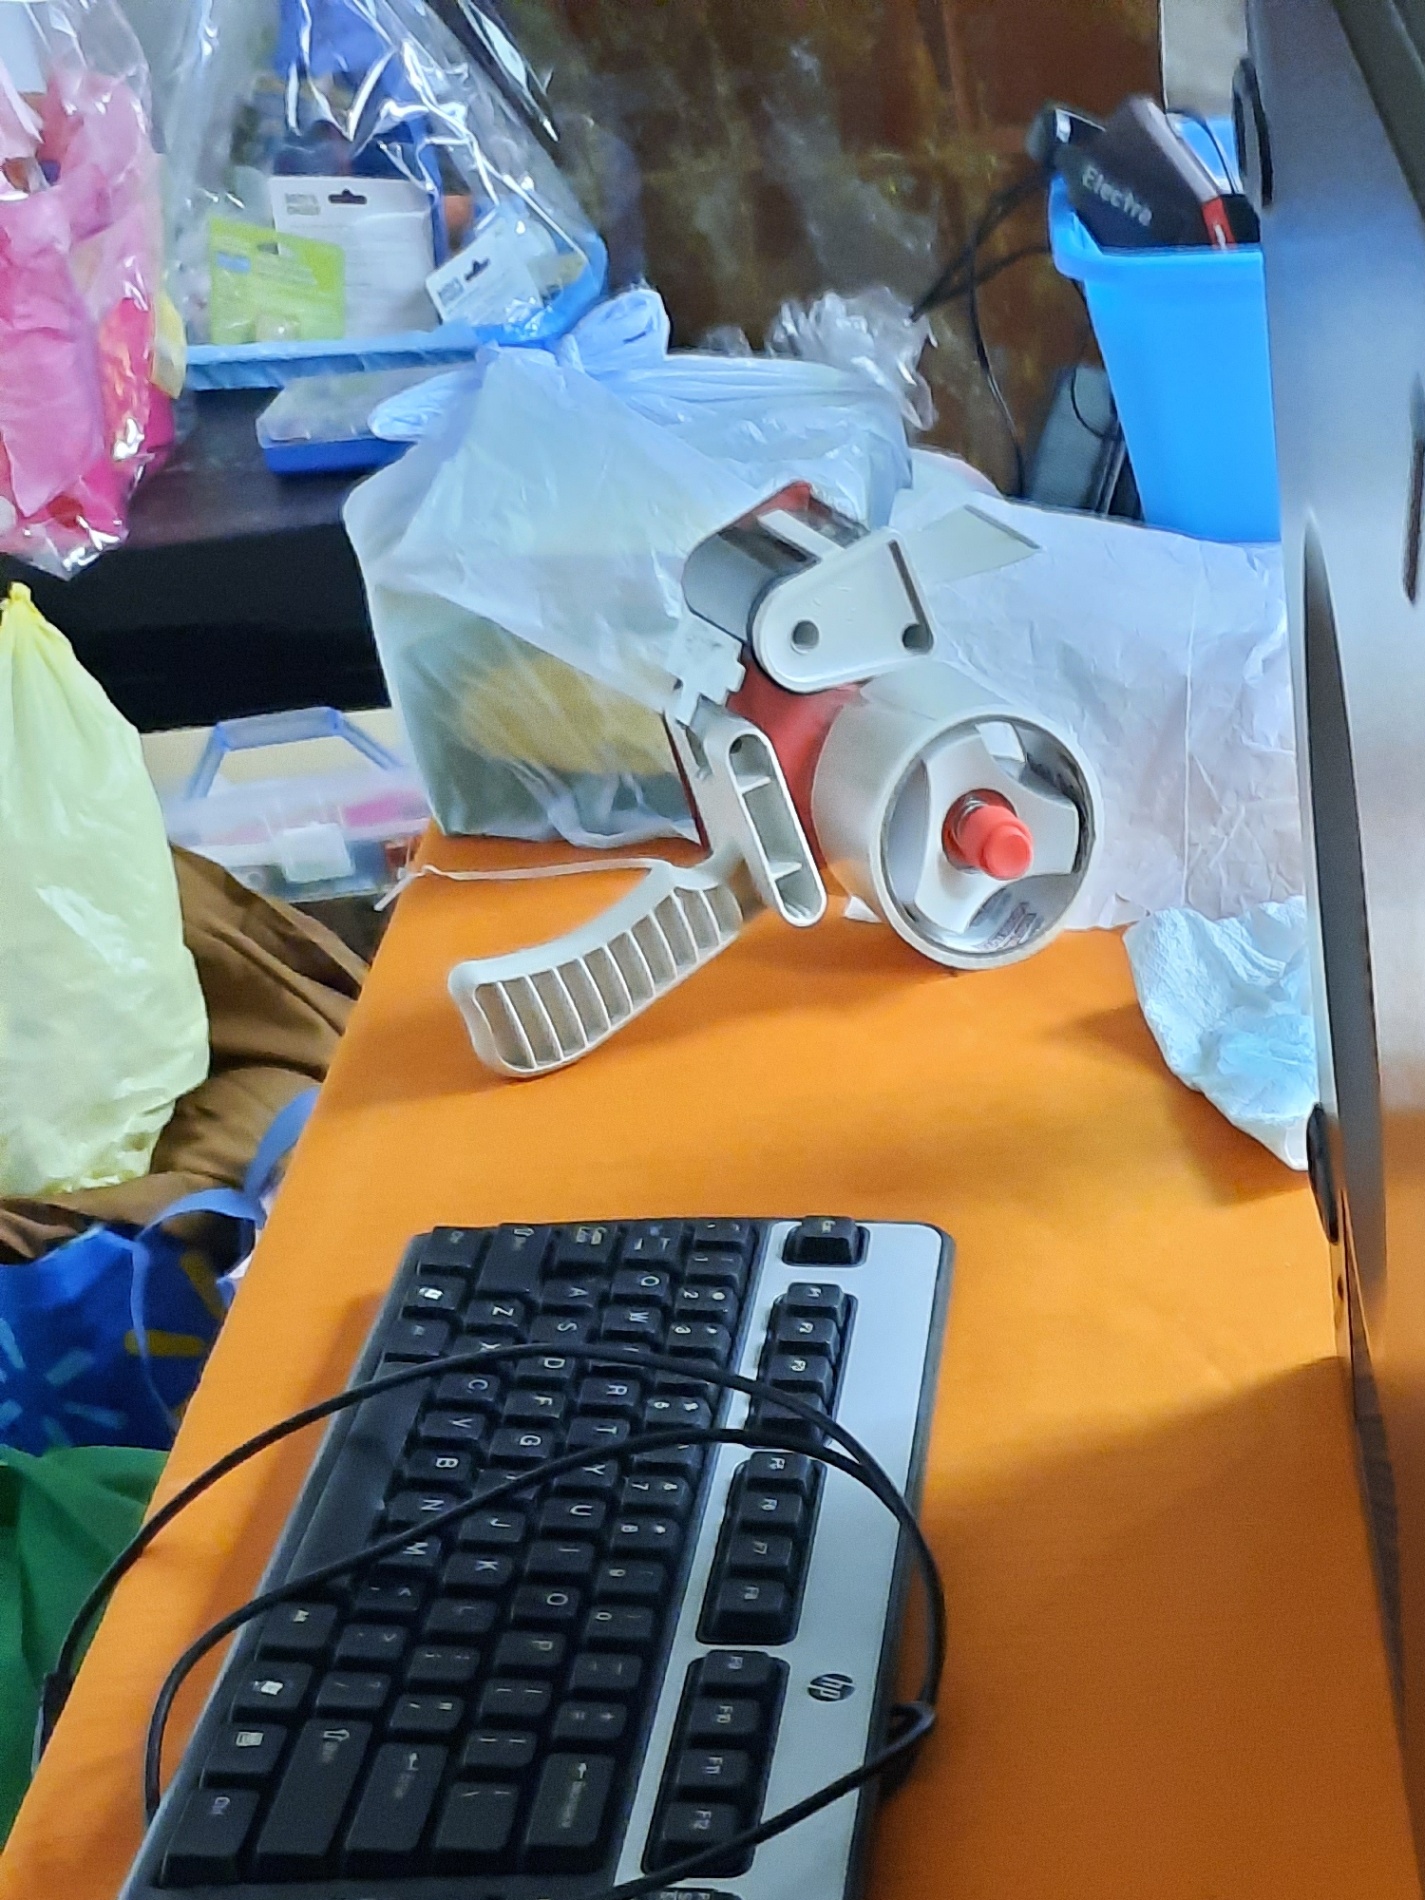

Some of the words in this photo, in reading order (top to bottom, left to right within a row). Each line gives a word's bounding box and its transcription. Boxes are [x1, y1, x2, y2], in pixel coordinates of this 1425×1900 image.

[568, 1286, 589, 1298] A
[684, 1291, 699, 1300] 2
[492, 1305, 514, 1317] Z
[629, 1310, 649, 1324] W
[557, 1321, 578, 1333] S
[543, 1357, 566, 1370] D
[467, 1378, 489, 1392] C
[606, 1384, 629, 1396] R
[534, 1395, 553, 1407] F
[450, 1417, 473, 1429] V
[594, 1425, 618, 1436] T
[519, 1434, 542, 1447] G
[435, 1456, 459, 1470] B
[582, 1463, 606, 1476] Y
[631, 1482, 650, 1491] 7
[420, 1498, 444, 1512] N
[569, 1504, 593, 1517] U
[489, 1516, 512, 1528] J
[402, 1541, 428, 1555] M
[475, 1559, 499, 1571] K
[546, 1592, 569, 1606] O
[595, 1611, 613, 1621] 0
[531, 1639, 553, 1650] P
[807, 1674, 856, 1700] hp
